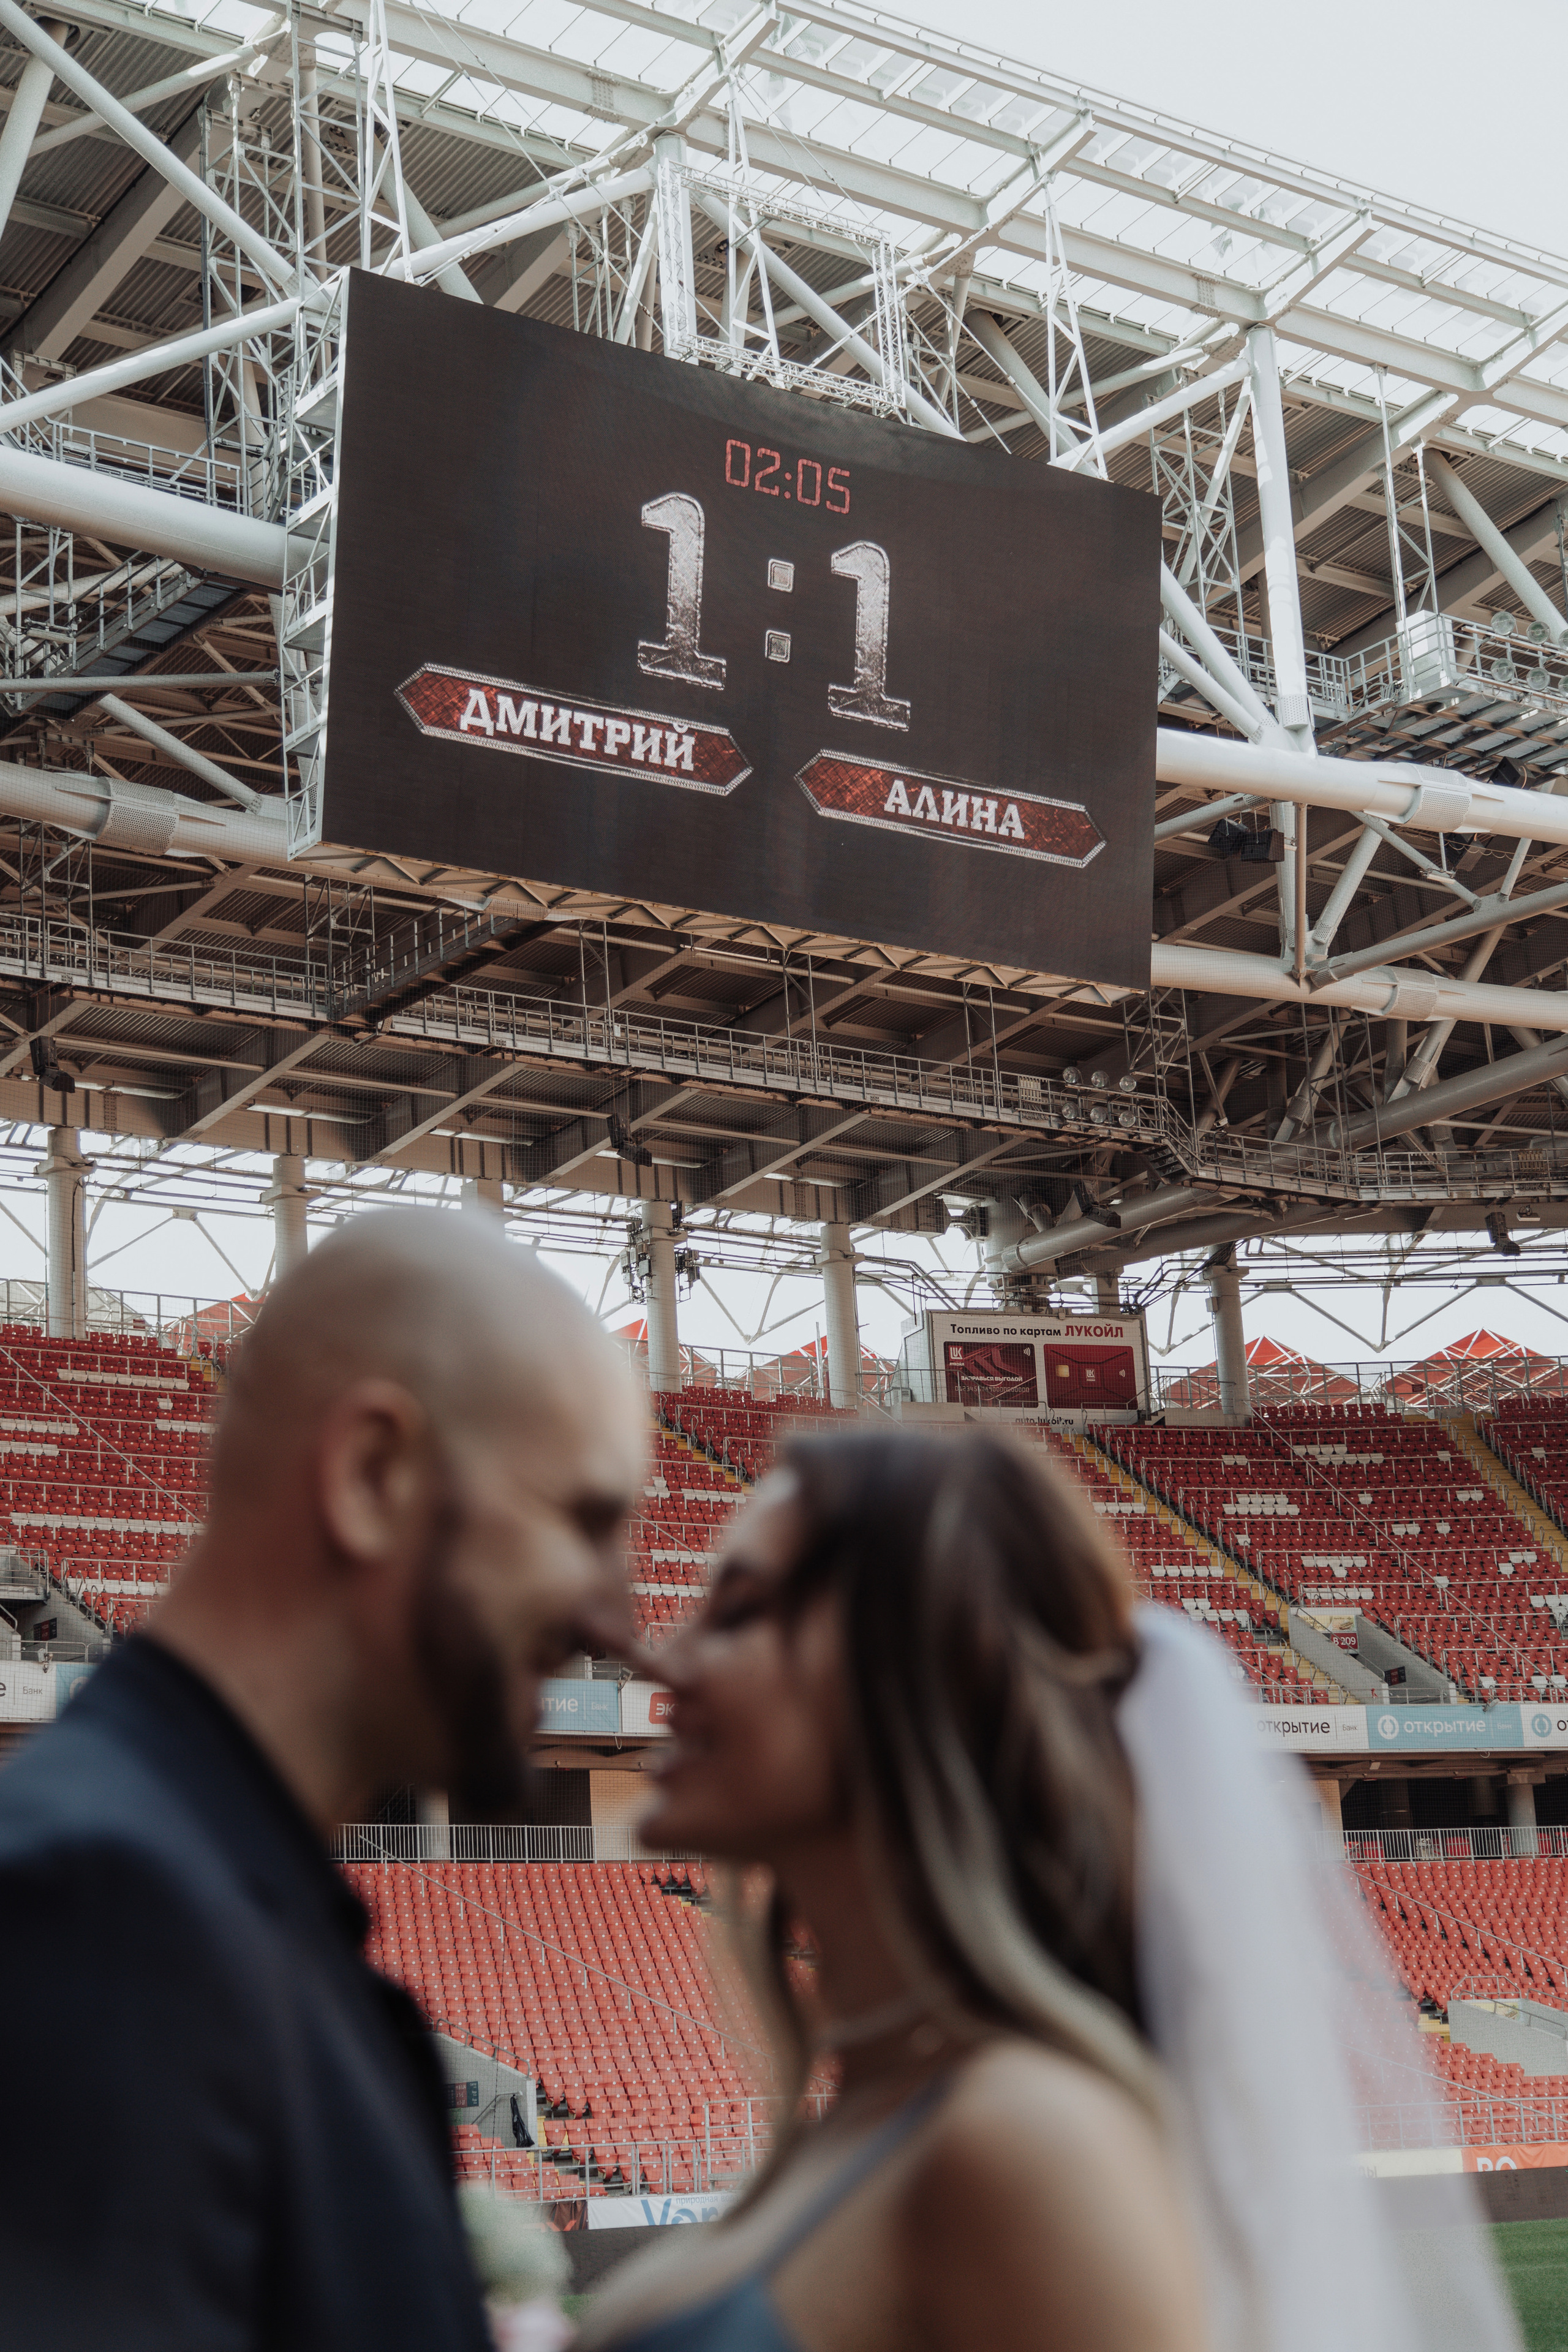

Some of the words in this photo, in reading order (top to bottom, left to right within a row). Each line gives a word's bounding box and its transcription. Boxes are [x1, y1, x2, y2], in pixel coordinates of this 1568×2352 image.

[725, 439, 850, 514] 02:05
[460, 688, 695, 771] ДМИТРИЙ
[884, 780, 1025, 840] АЛИНА
[951, 1324, 1000, 1335] Топливо
[1003, 1327, 1017, 1335] по
[1020, 1327, 1061, 1338] картам
[1065, 1324, 1124, 1338] ЛУКОЙЛ
[1341, 1637, 1356, 1645] 209
[23, 1686, 43, 1695] Банк
[591, 1702, 608, 1711] Банк
[1257, 1719, 1330, 1738] открытие
[1404, 1720, 1486, 1738] открытие
[676, 2196, 718, 2206] природная
